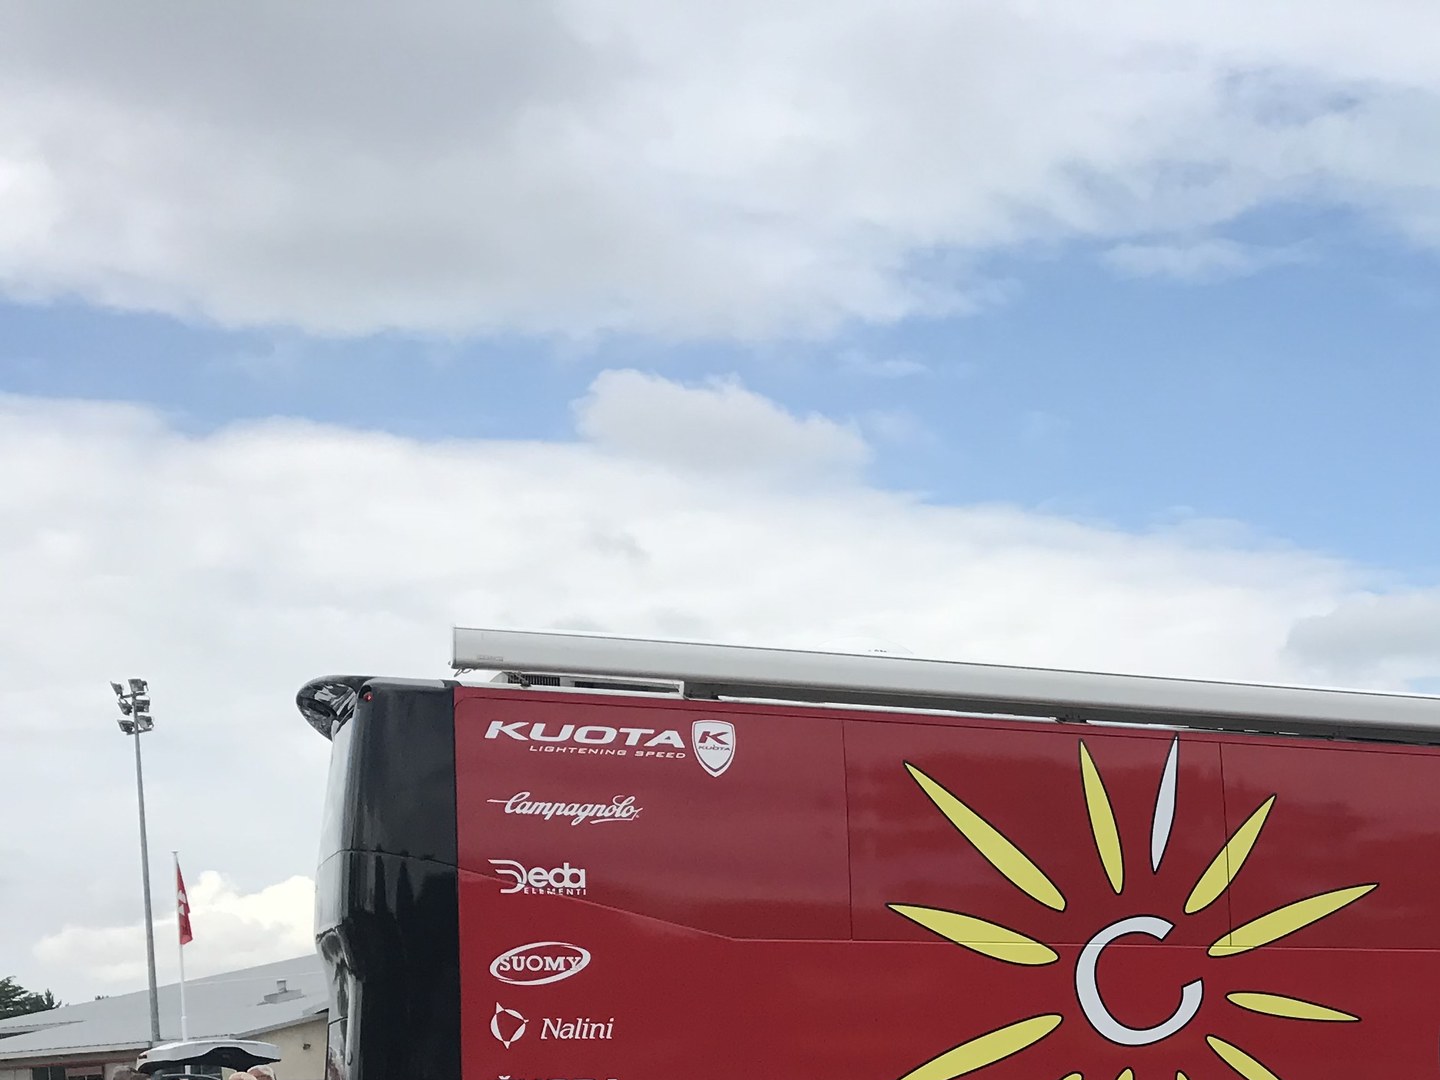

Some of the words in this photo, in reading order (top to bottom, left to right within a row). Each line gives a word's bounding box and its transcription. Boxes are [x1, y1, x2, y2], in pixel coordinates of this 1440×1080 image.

[484, 719, 686, 749] KUOTA
[698, 730, 729, 746] K
[529, 745, 627, 756] LIGHTENING
[634, 750, 686, 759] SPEED
[487, 791, 643, 826] Campagnolo
[488, 859, 586, 894] Deda
[524, 887, 587, 896] ELEMENTI
[499, 955, 582, 971] SUOMY
[1074, 913, 1204, 1048] C
[540, 1017, 615, 1040] Nalini
